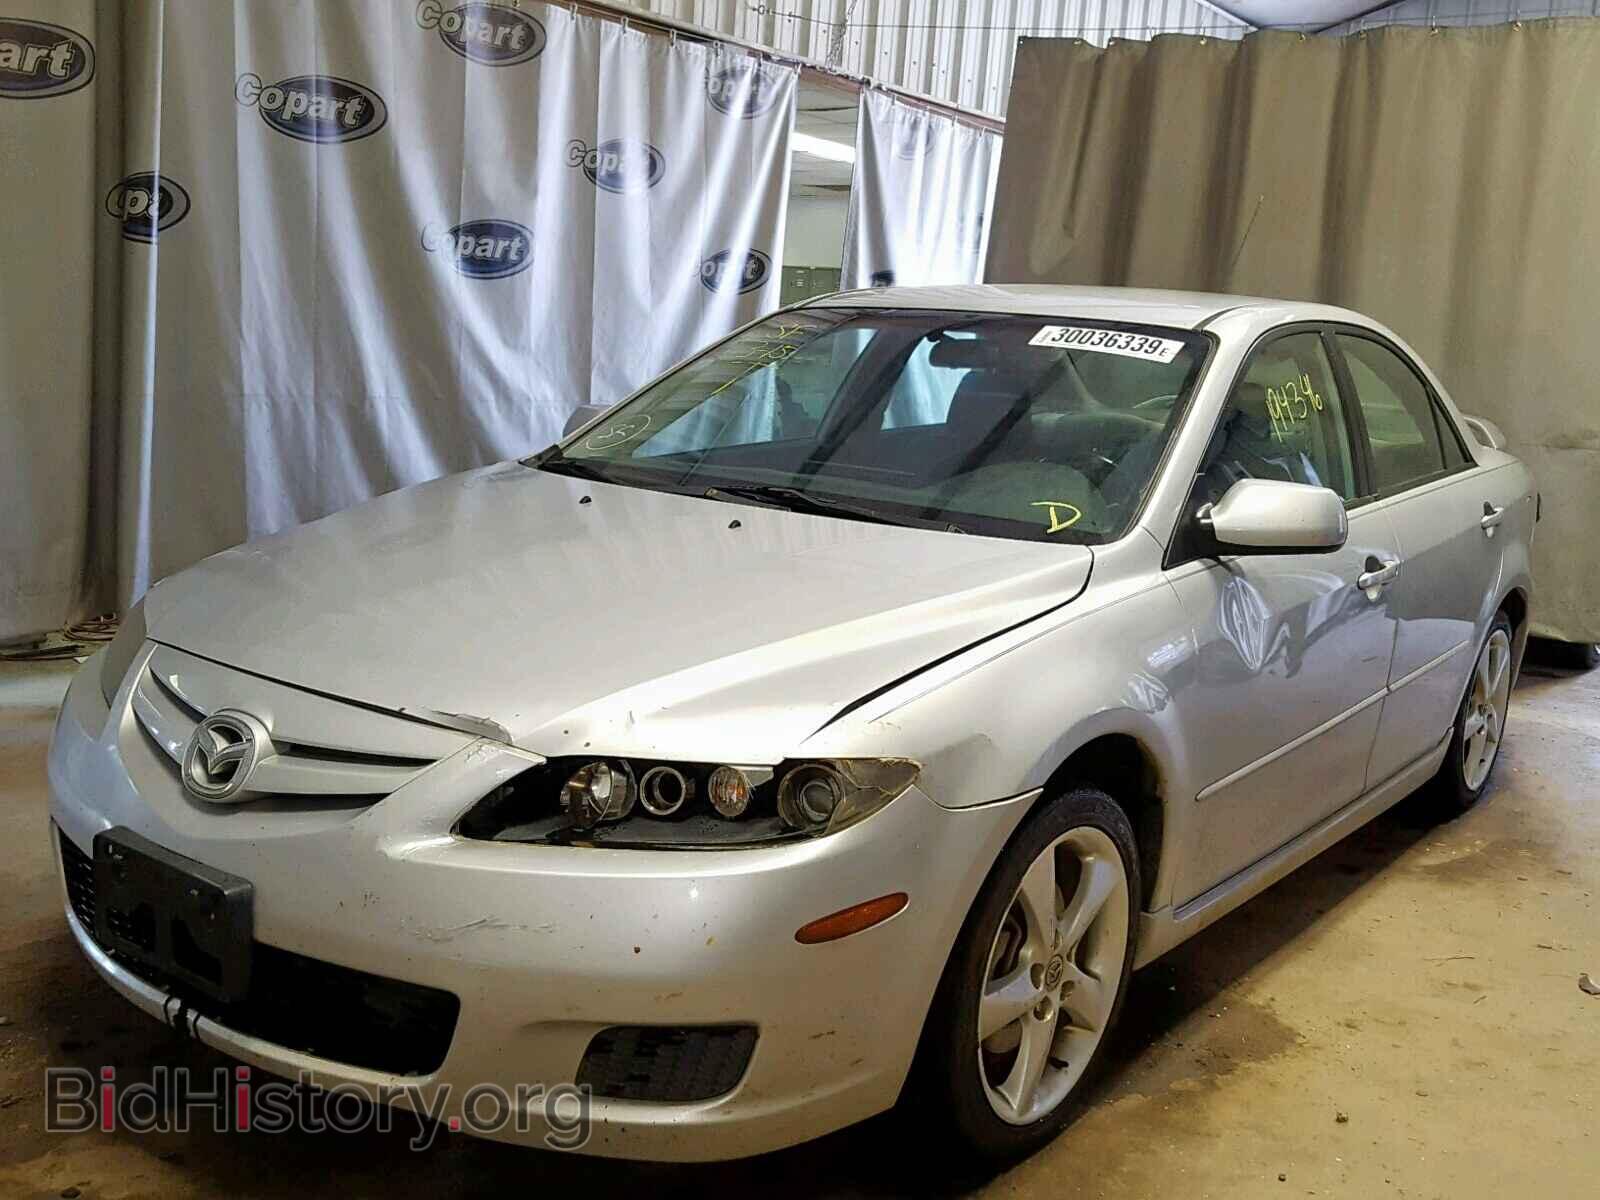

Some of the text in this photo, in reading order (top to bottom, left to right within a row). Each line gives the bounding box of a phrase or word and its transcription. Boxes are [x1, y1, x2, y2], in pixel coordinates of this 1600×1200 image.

[235, 73, 367, 128] Copart
[1052, 328, 1163, 355] 30036339
[1031, 501, 1081, 534] D
